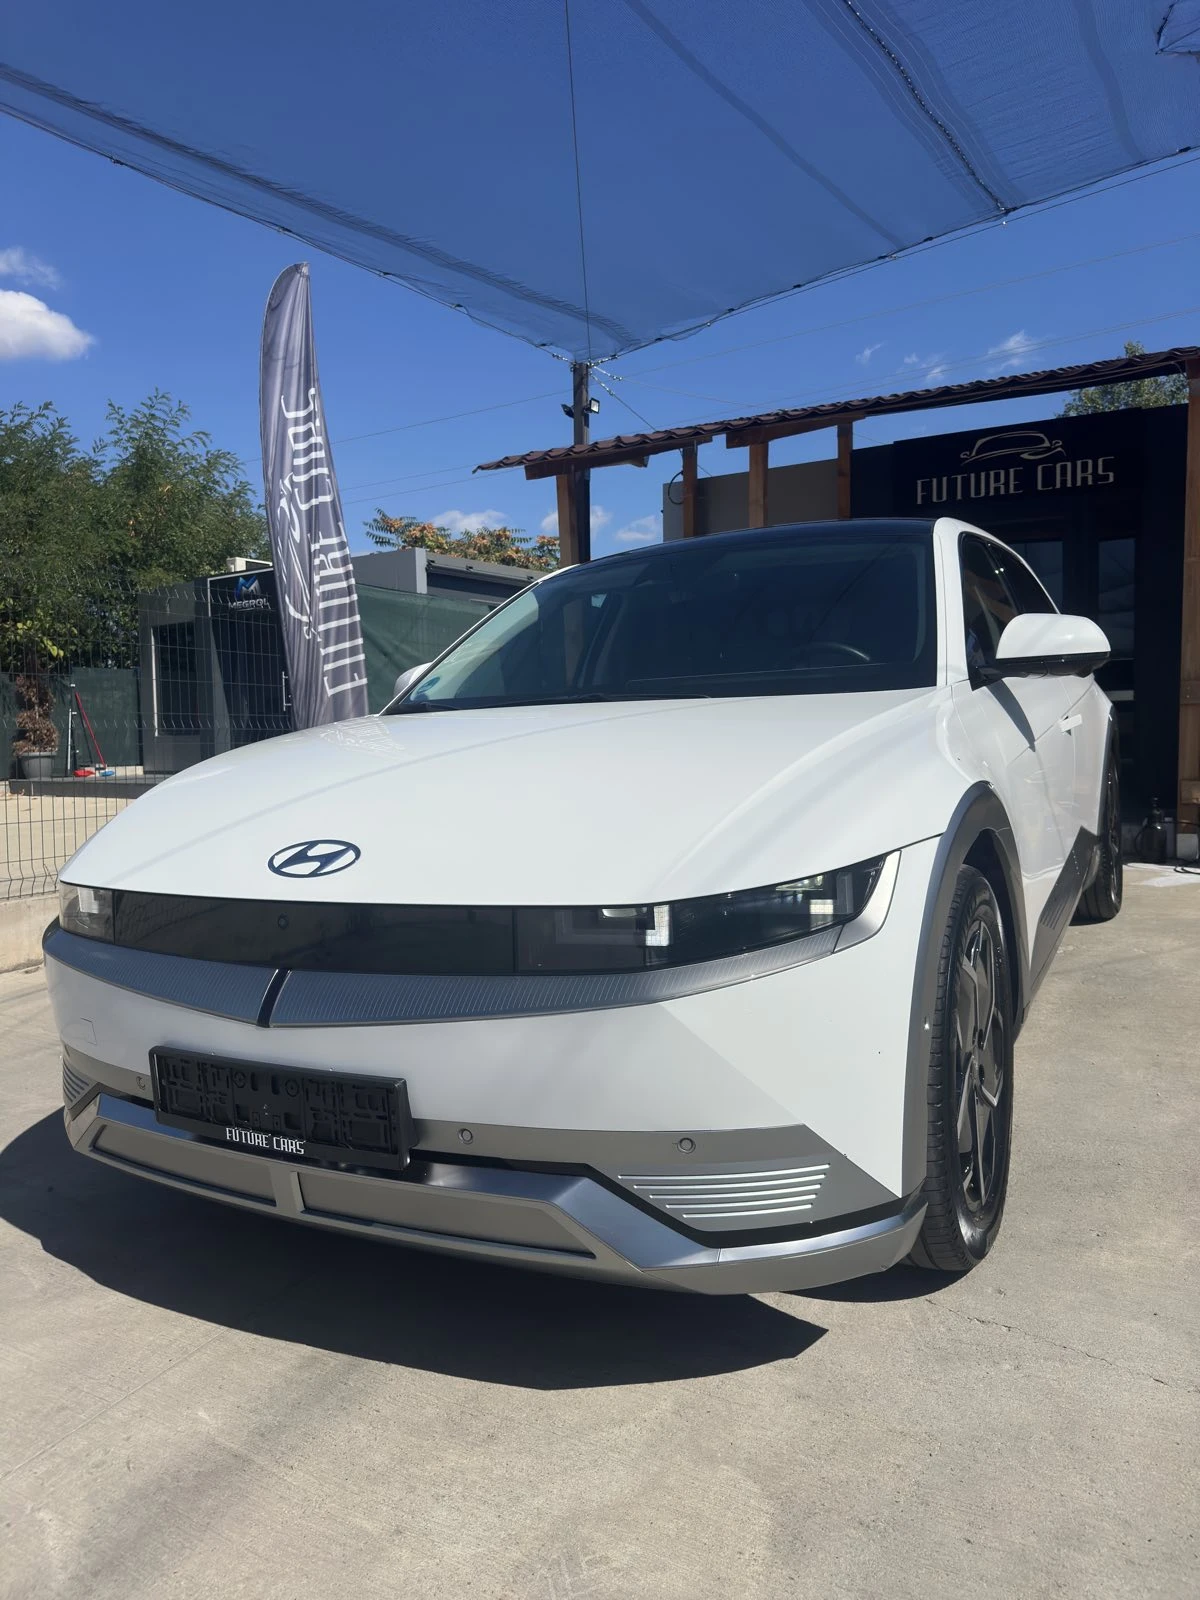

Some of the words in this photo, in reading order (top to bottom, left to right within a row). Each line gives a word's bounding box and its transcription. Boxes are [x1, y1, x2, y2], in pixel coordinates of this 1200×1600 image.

[916, 467, 1024, 505] FUTURE
[1037, 456, 1115, 491] CARS
[225, 1126, 271, 1148] FUTURE
[272, 1135, 306, 1155] CARS
